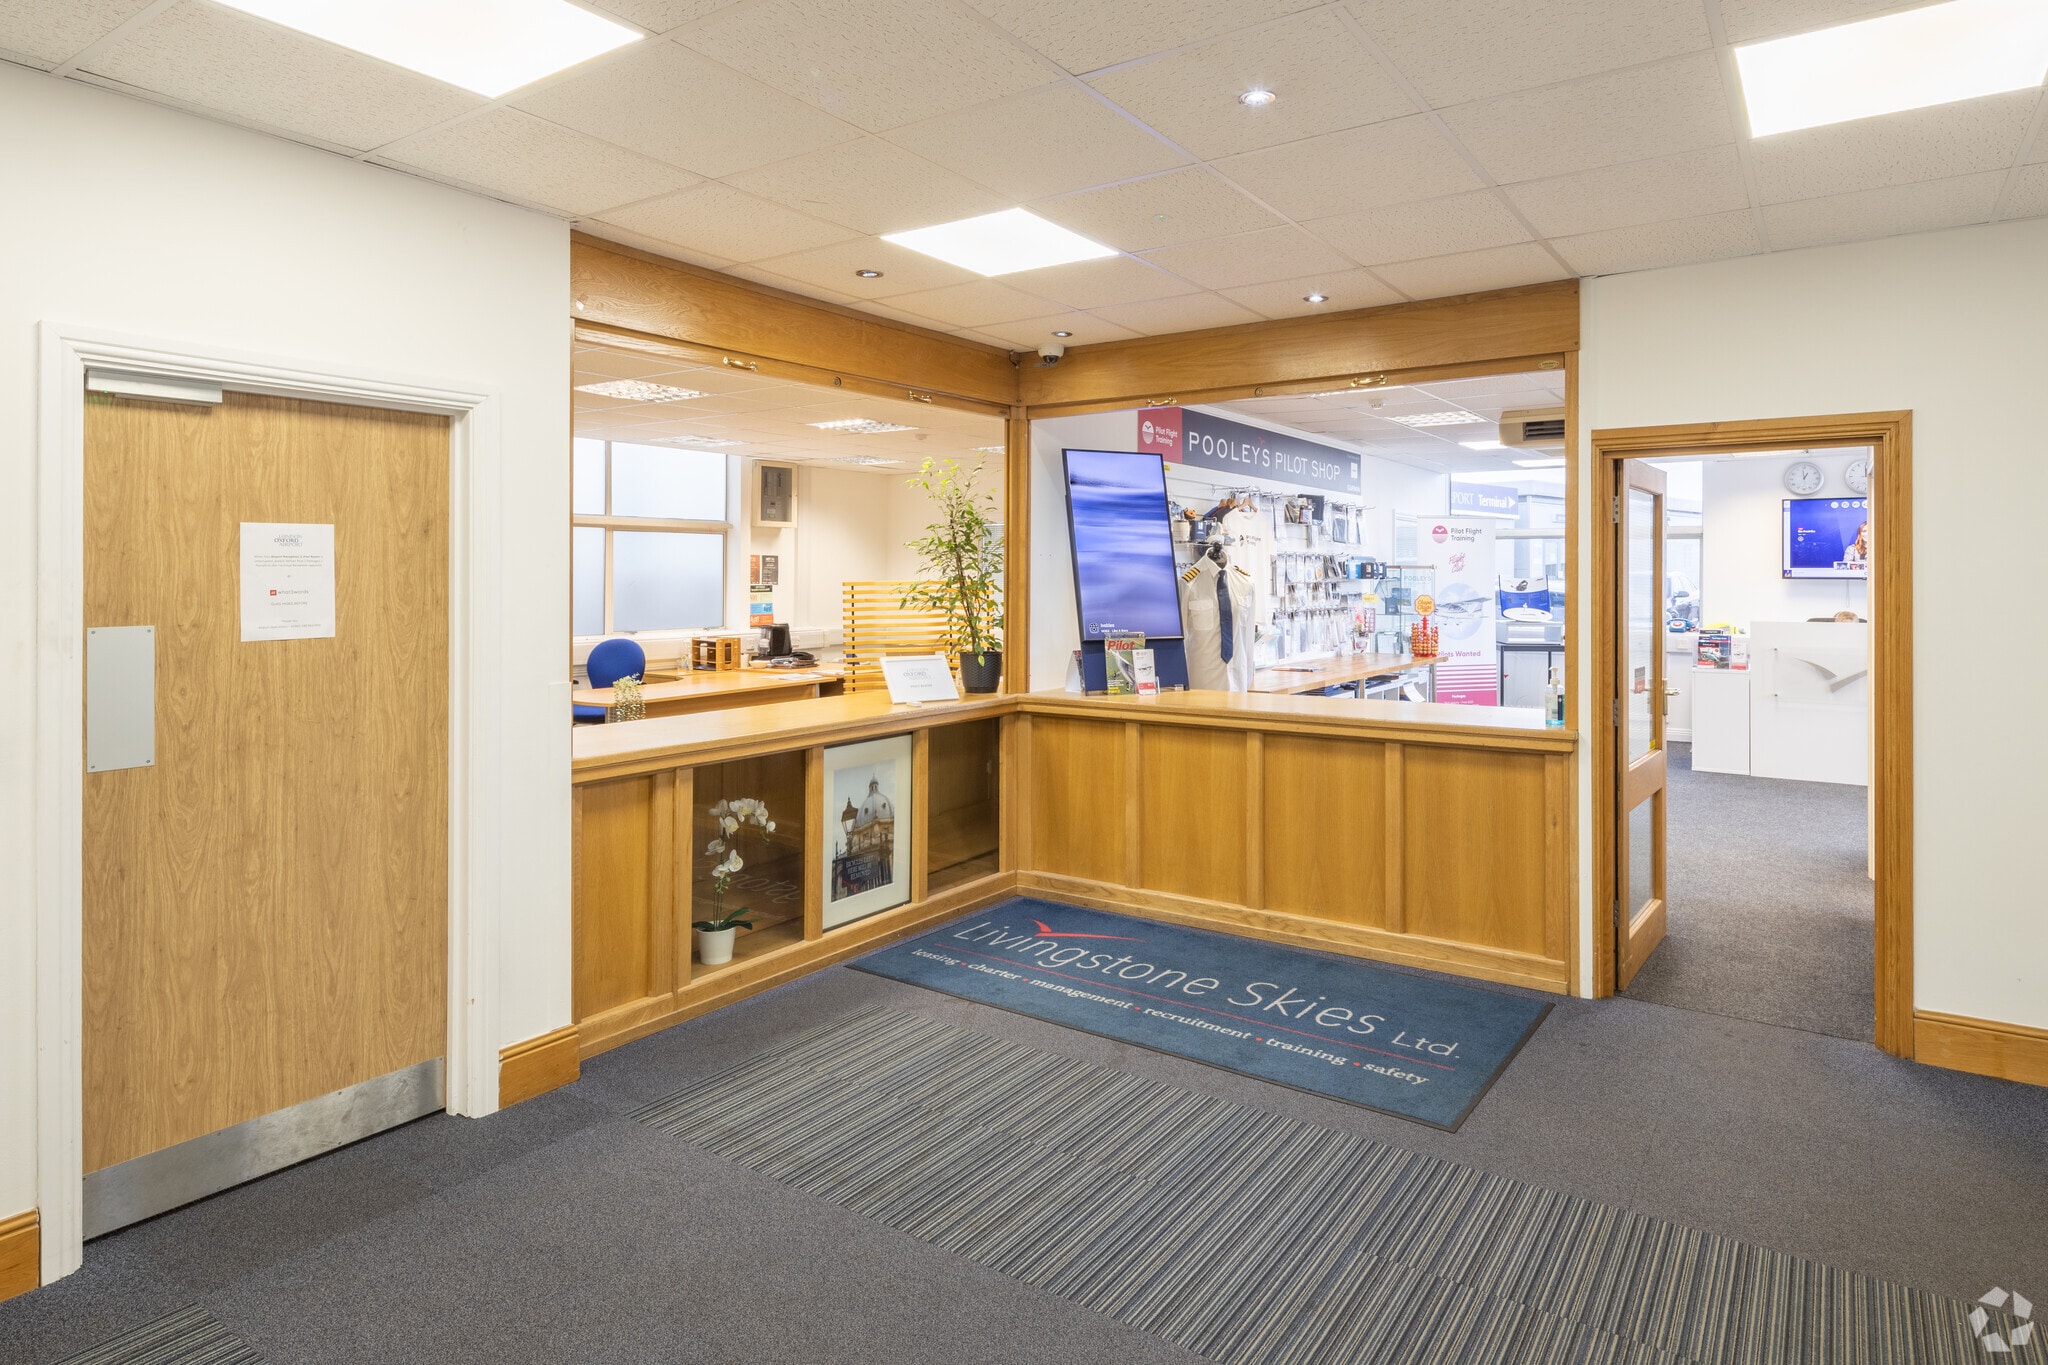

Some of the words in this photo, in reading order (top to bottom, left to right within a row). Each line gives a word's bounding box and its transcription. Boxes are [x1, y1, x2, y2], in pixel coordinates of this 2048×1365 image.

[1155, 426, 1165, 435] Pilot
[1166, 428, 1178, 439] Flight
[1155, 435, 1173, 447] Training
[1275, 451, 1308, 476] PILOT
[1311, 459, 1341, 481] SHOP
[1452, 491, 1474, 505] PORT
[1478, 494, 1507, 508] Terminal
[1466, 528, 1482, 536] Flight
[1450, 535, 1475, 543] Training
[1107, 639, 1135, 651] Pilot
[953, 921, 1220, 995] Livingstone
[1227, 982, 1385, 1035] Skies
[1391, 1031, 1460, 1059] Ltd.
[911, 948, 961, 966] leasing
[967, 963, 1022, 981] charter
[1029, 978, 1134, 1009] management
[1142, 1007, 1252, 1040] recruitment
[1265, 1037, 1349, 1067] training
[1362, 1062, 1430, 1086] safety
